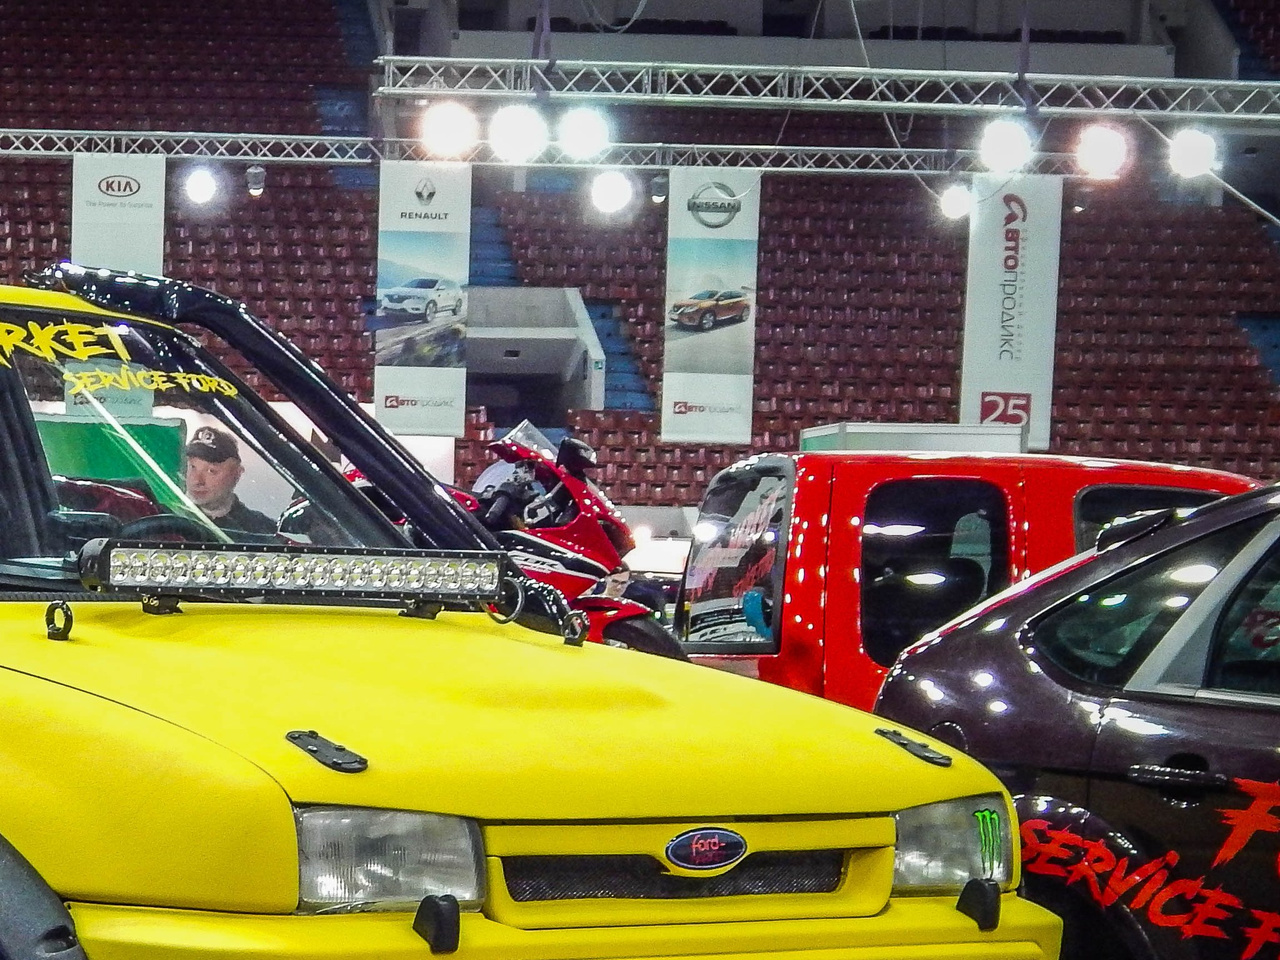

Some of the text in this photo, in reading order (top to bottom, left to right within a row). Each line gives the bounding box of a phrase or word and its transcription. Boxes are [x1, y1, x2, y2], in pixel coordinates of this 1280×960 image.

[105, 180, 133, 192] KIA
[692, 201, 737, 210] NISSAN
[400, 211, 449, 220] RENAULT
[174, 371, 239, 398] FORD
[982, 395, 1029, 427] 25
